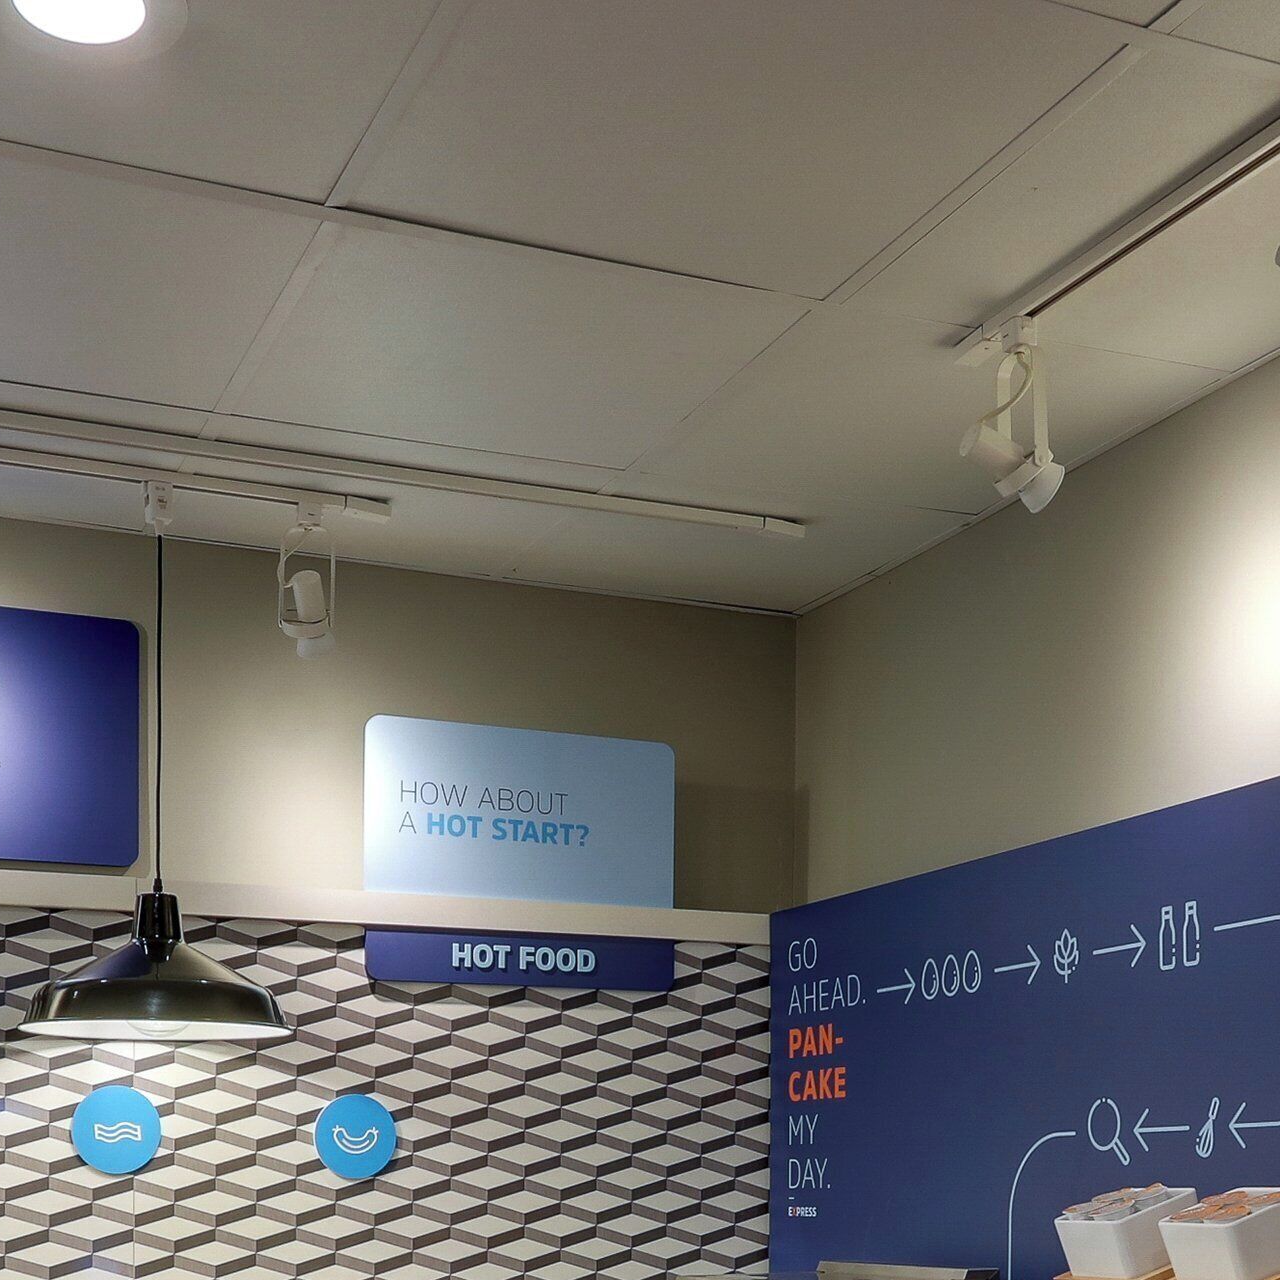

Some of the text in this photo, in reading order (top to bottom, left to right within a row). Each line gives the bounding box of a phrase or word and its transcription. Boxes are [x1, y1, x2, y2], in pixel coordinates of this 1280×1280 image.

[399, 780, 569, 816] HOW ABOUT
[398, 811, 590, 847] A HOT START?
[451, 942, 596, 973] HOT FOOD
[788, 937, 818, 972] GO
[788, 974, 866, 1016] AHEAD.
[788, 1023, 844, 1059] PAN-
[788, 1067, 847, 1102] CAKE
[788, 1113, 819, 1146] MY
[788, 1158, 831, 1189] DAY.
[788, 1206, 817, 1217] EXPRESS
